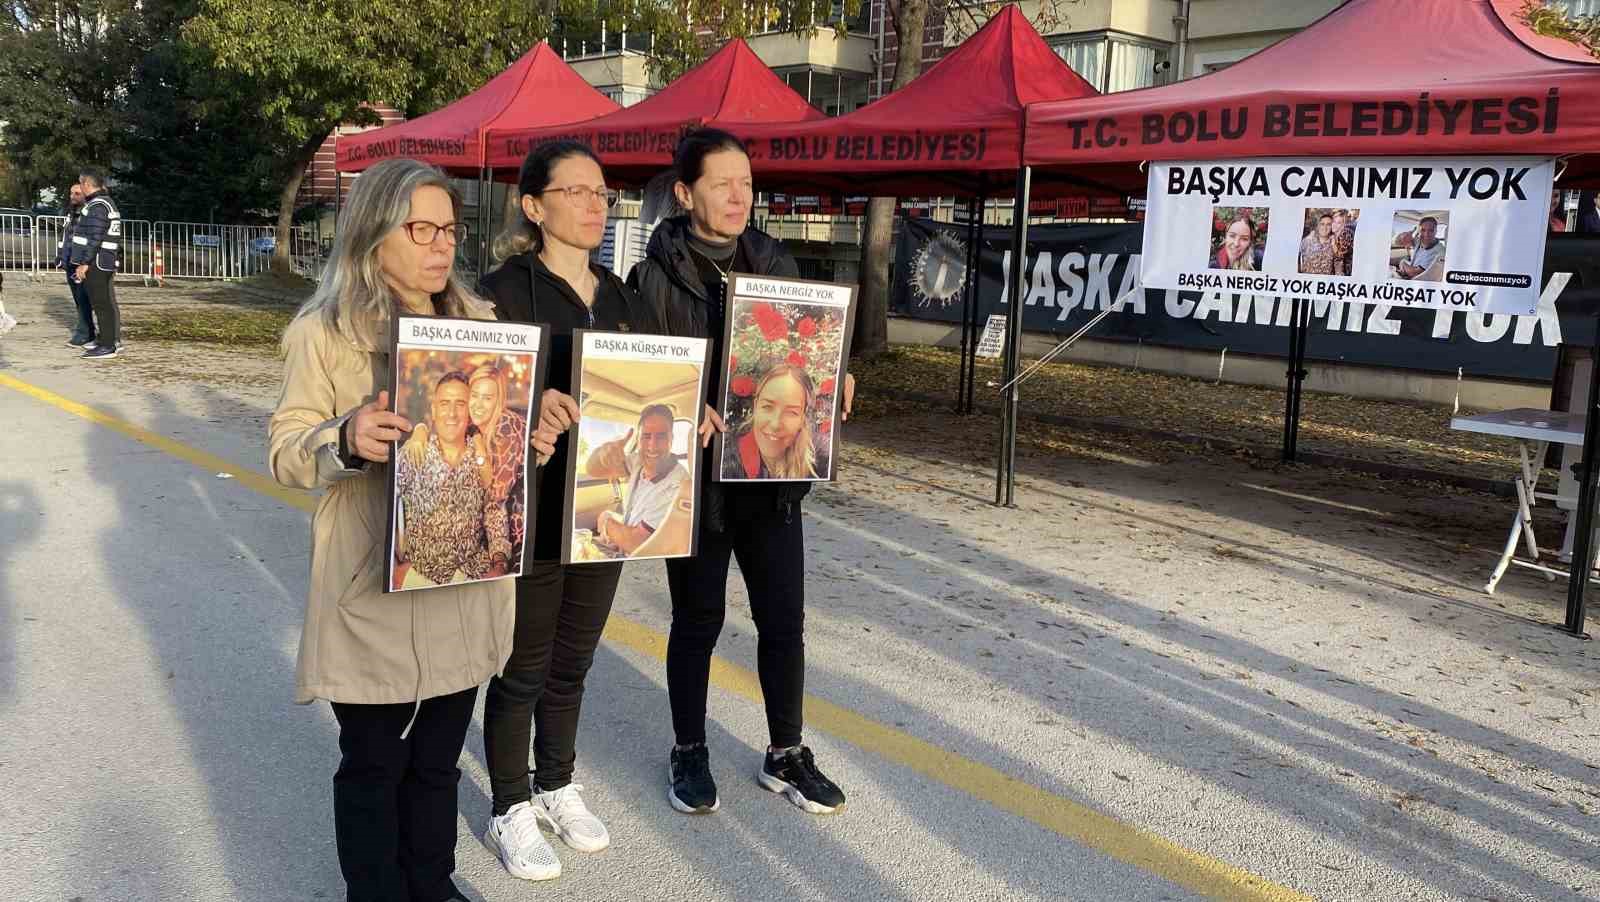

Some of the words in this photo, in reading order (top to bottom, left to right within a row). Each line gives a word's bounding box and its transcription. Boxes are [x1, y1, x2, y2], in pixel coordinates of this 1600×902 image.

[1067, 117, 1128, 150] T.C.
[1141, 106, 1249, 145] BOLU
[1261, 87, 1561, 138] BELEDİYESİ
[768, 136, 832, 161] BOLU
[833, 128, 989, 161] BELEDİYESİ
[1167, 166, 1271, 203] BAŞKA
[1280, 166, 1433, 199] CANIMIZ
[1444, 167, 1531, 200] YOK
[745, 281, 777, 294] BAŞKA
[779, 284, 814, 298] NERGİZ
[815, 289, 834, 300] YOK
[1178, 273, 1223, 289] BAŞKA
[1226, 274, 1278, 292] NERGİZ
[1282, 279, 1313, 294] YOK
[1316, 282, 1368, 301] BAŞKA
[1373, 282, 1436, 305] KÜRŞAT
[1440, 289, 1477, 307] YOK
[412, 324, 452, 341] BAŞKA
[455, 328, 503, 345] CANIMIZ
[505, 333, 528, 346] YOK
[594, 339, 629, 353] BAŞKA
[631, 340, 668, 357] KÜRŞAT
[670, 345, 691, 357] YOK
